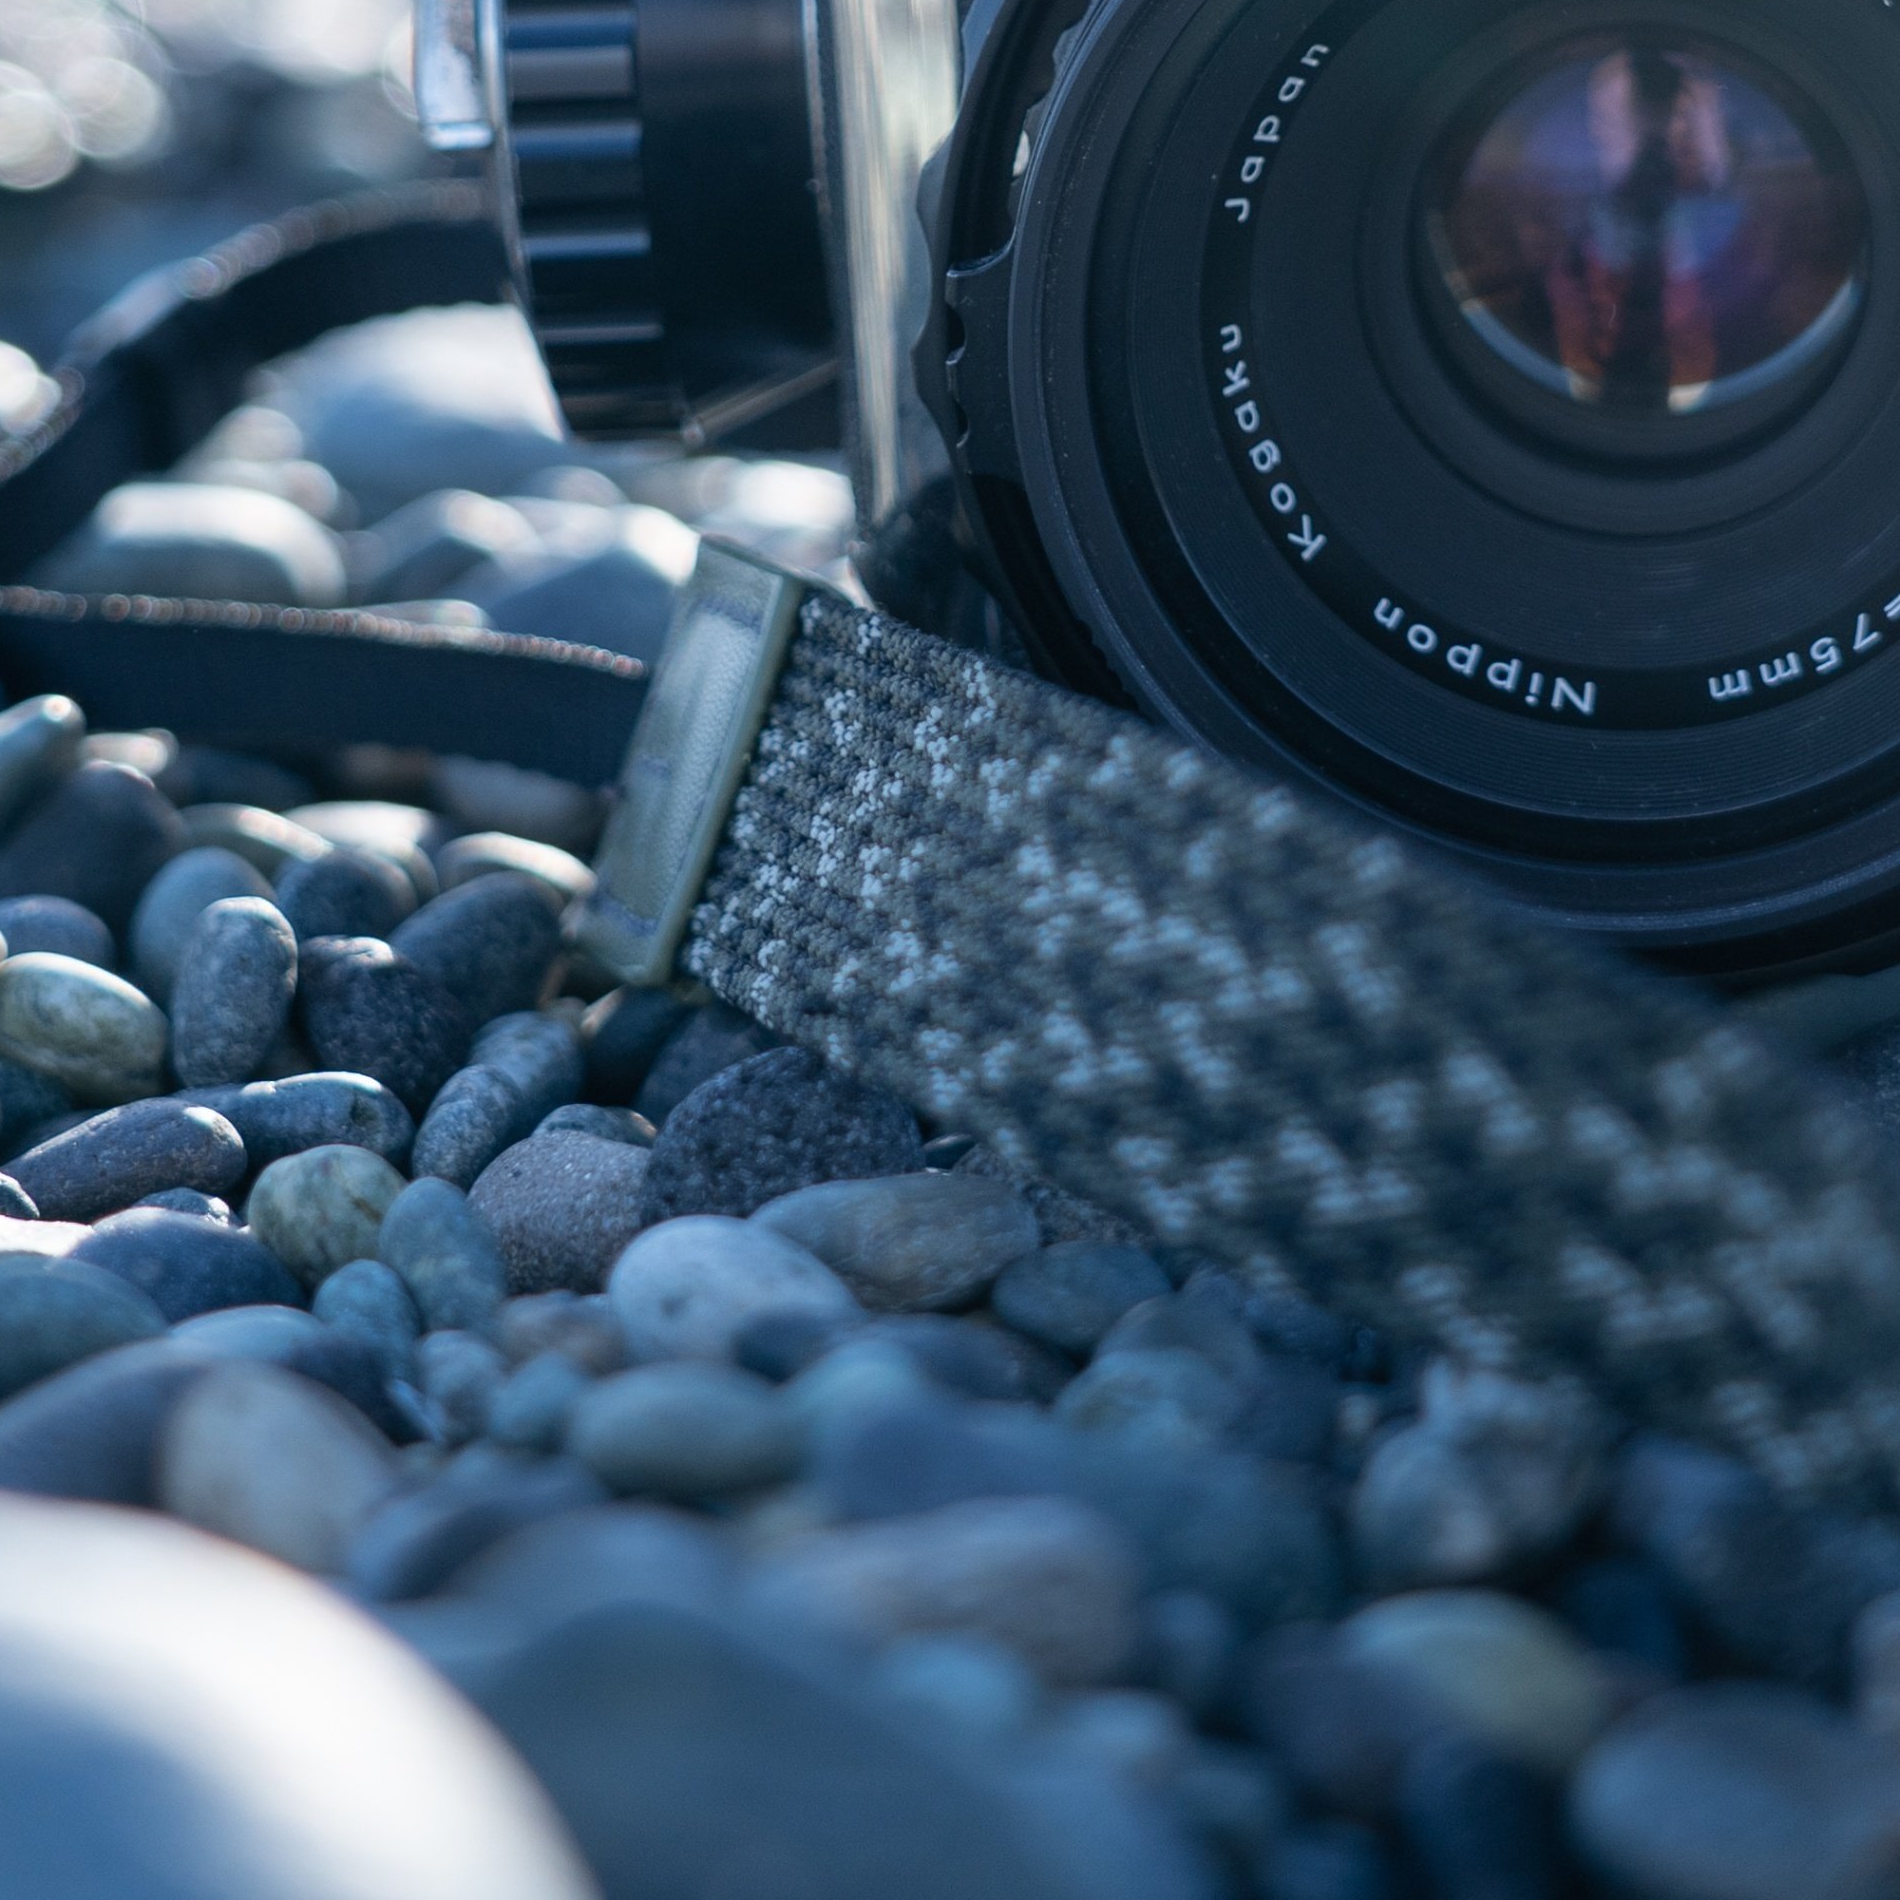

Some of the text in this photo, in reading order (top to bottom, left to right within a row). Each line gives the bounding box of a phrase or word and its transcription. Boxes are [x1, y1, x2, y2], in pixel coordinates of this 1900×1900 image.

[1224, 43, 1330, 223] Japan
[1219, 323, 1327, 561] Kogaku
[1373, 597, 1597, 715] Nippon
